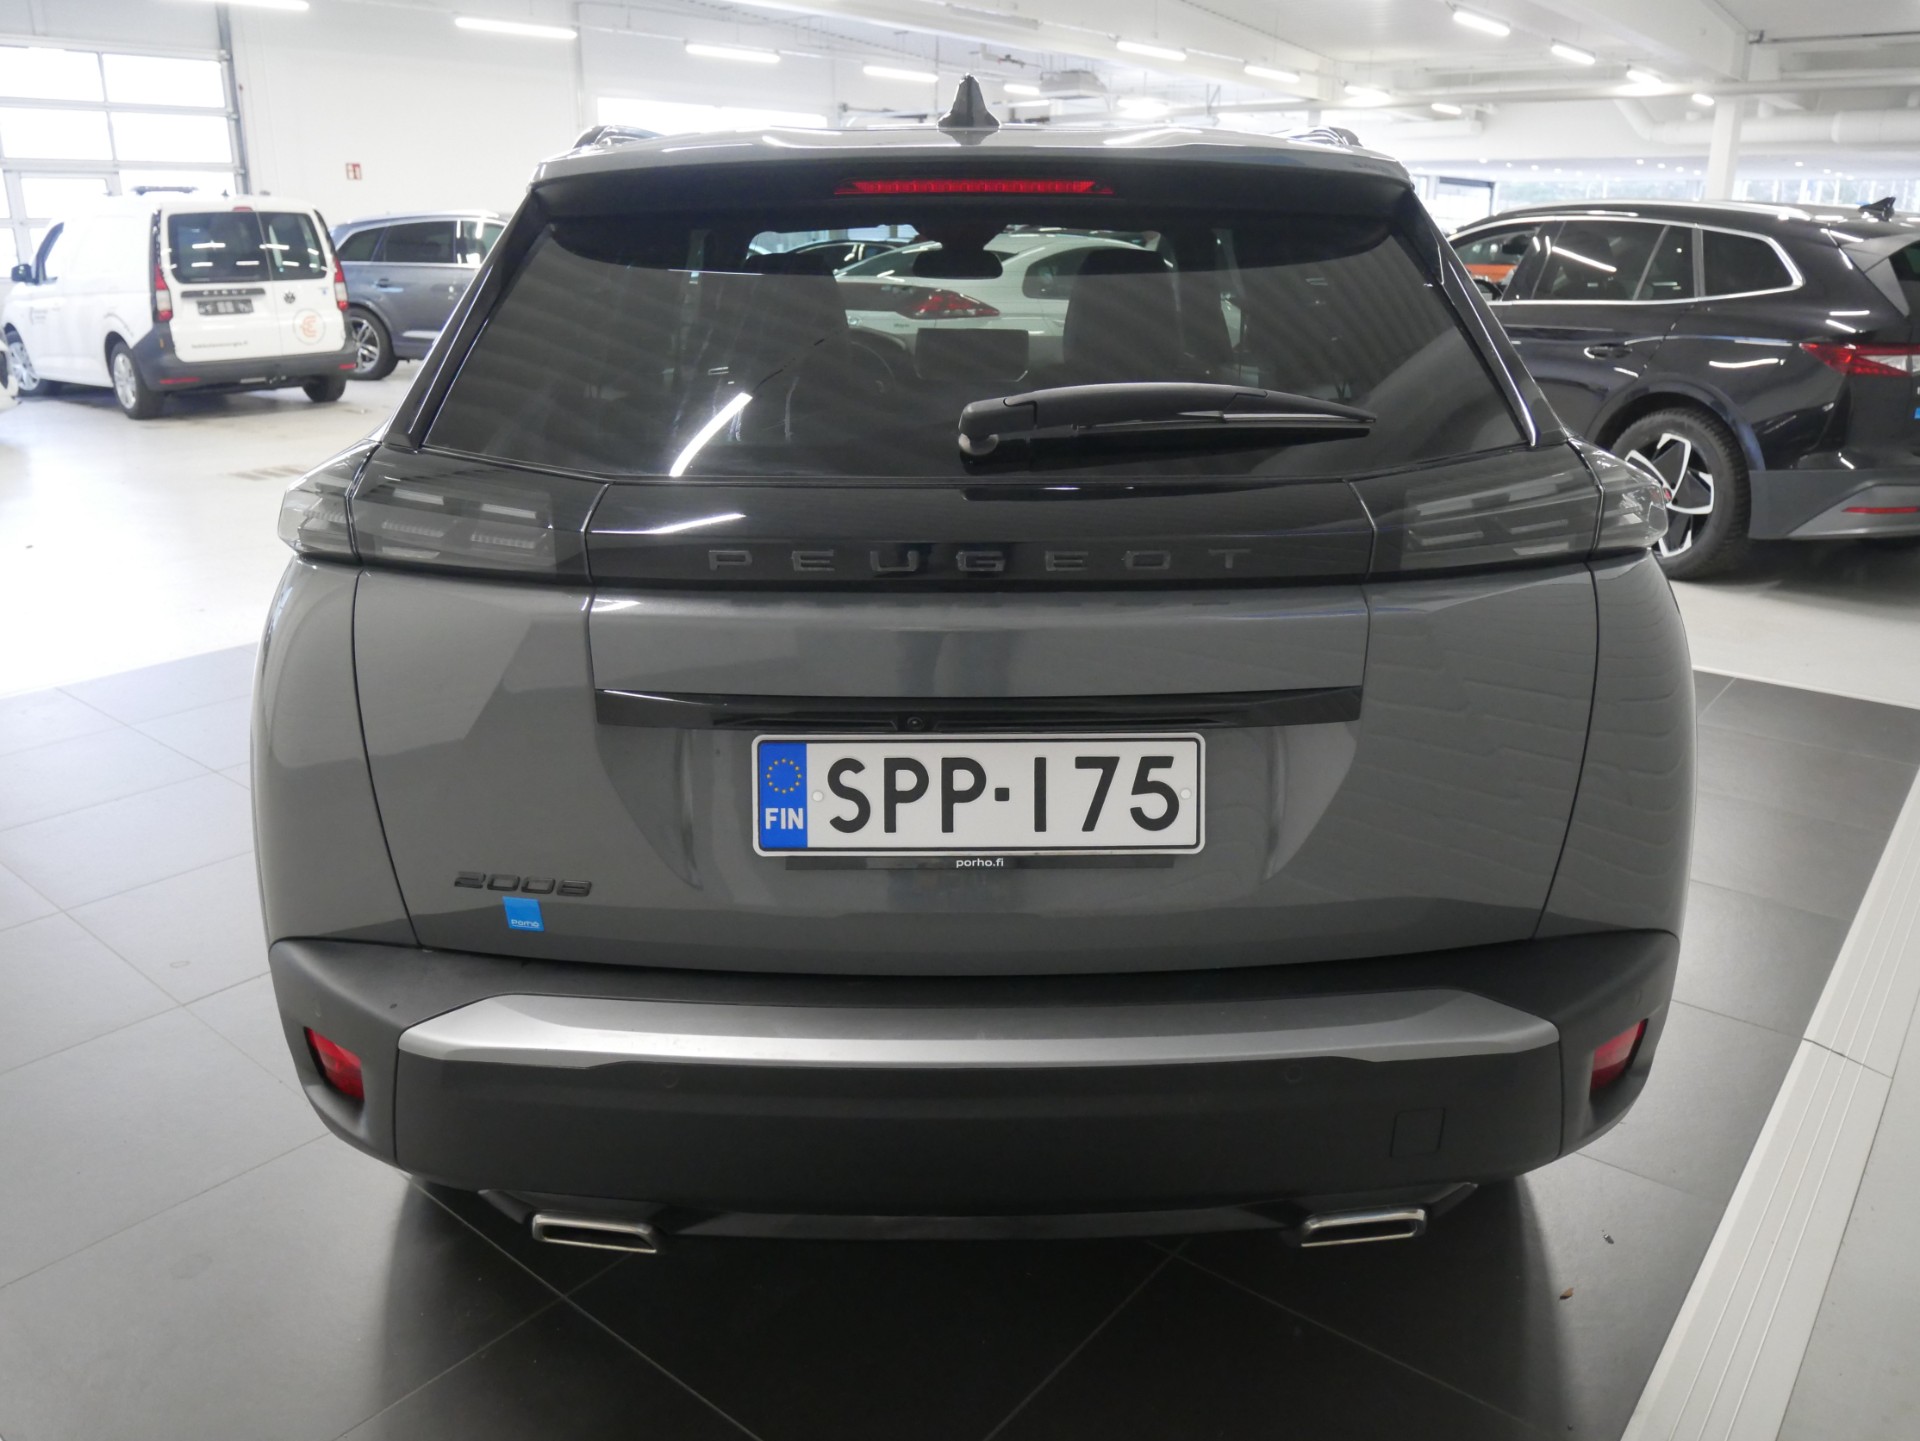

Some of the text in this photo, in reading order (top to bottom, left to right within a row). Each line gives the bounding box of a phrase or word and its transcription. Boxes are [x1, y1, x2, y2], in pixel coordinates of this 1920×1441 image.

[707, 547, 1252, 573] PEUGEOT
[826, 755, 1181, 834] SPP-175
[764, 807, 804, 830] FIN
[956, 857, 1004, 869] porho.fi
[454, 870, 592, 898] 2008
